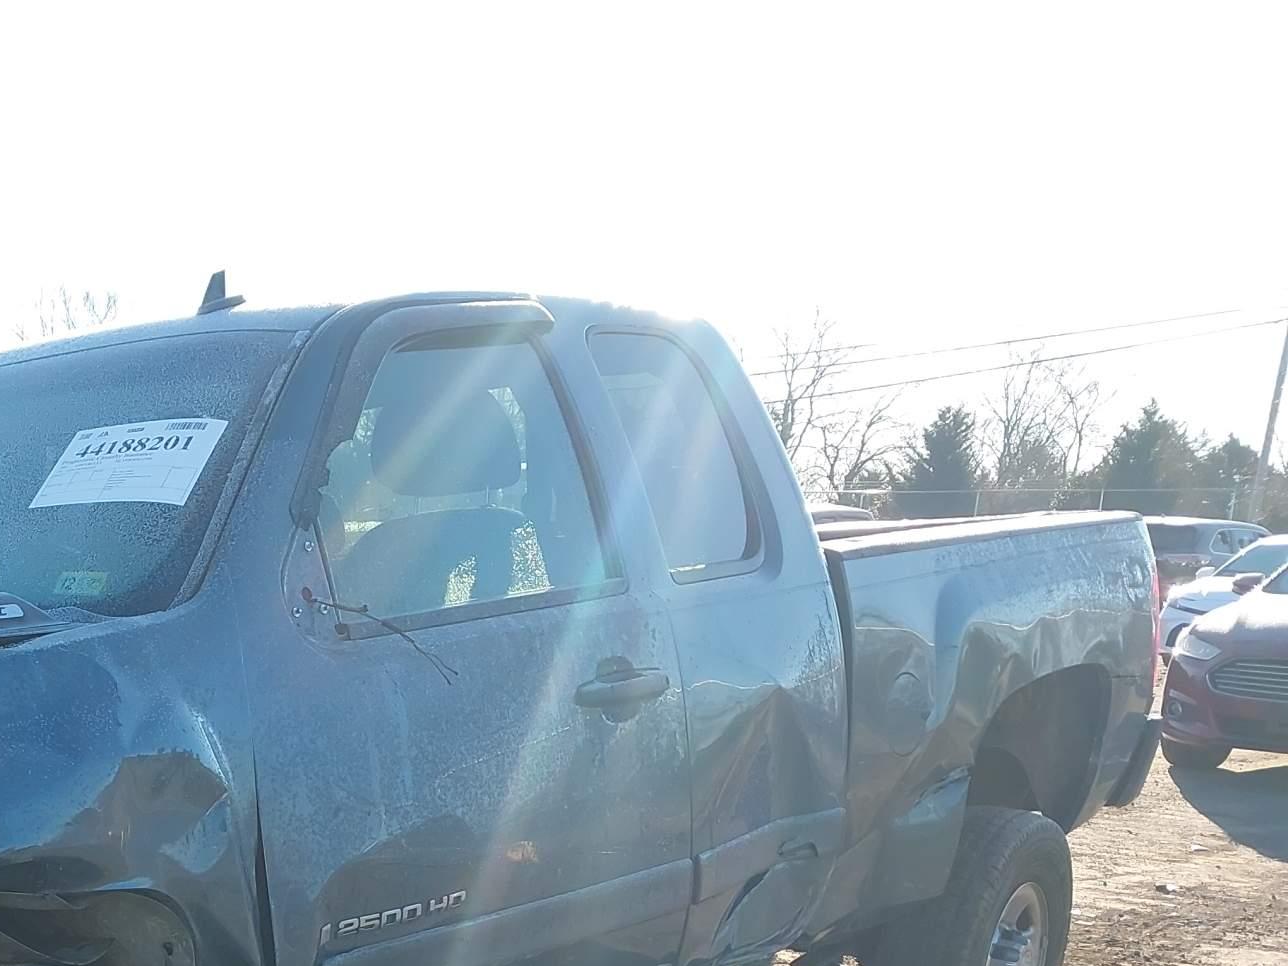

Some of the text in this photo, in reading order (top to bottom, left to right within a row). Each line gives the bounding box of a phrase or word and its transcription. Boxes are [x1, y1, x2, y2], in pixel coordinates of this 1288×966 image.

[75, 435, 194, 458] 44188201
[336, 889, 467, 937] 2500 HD
